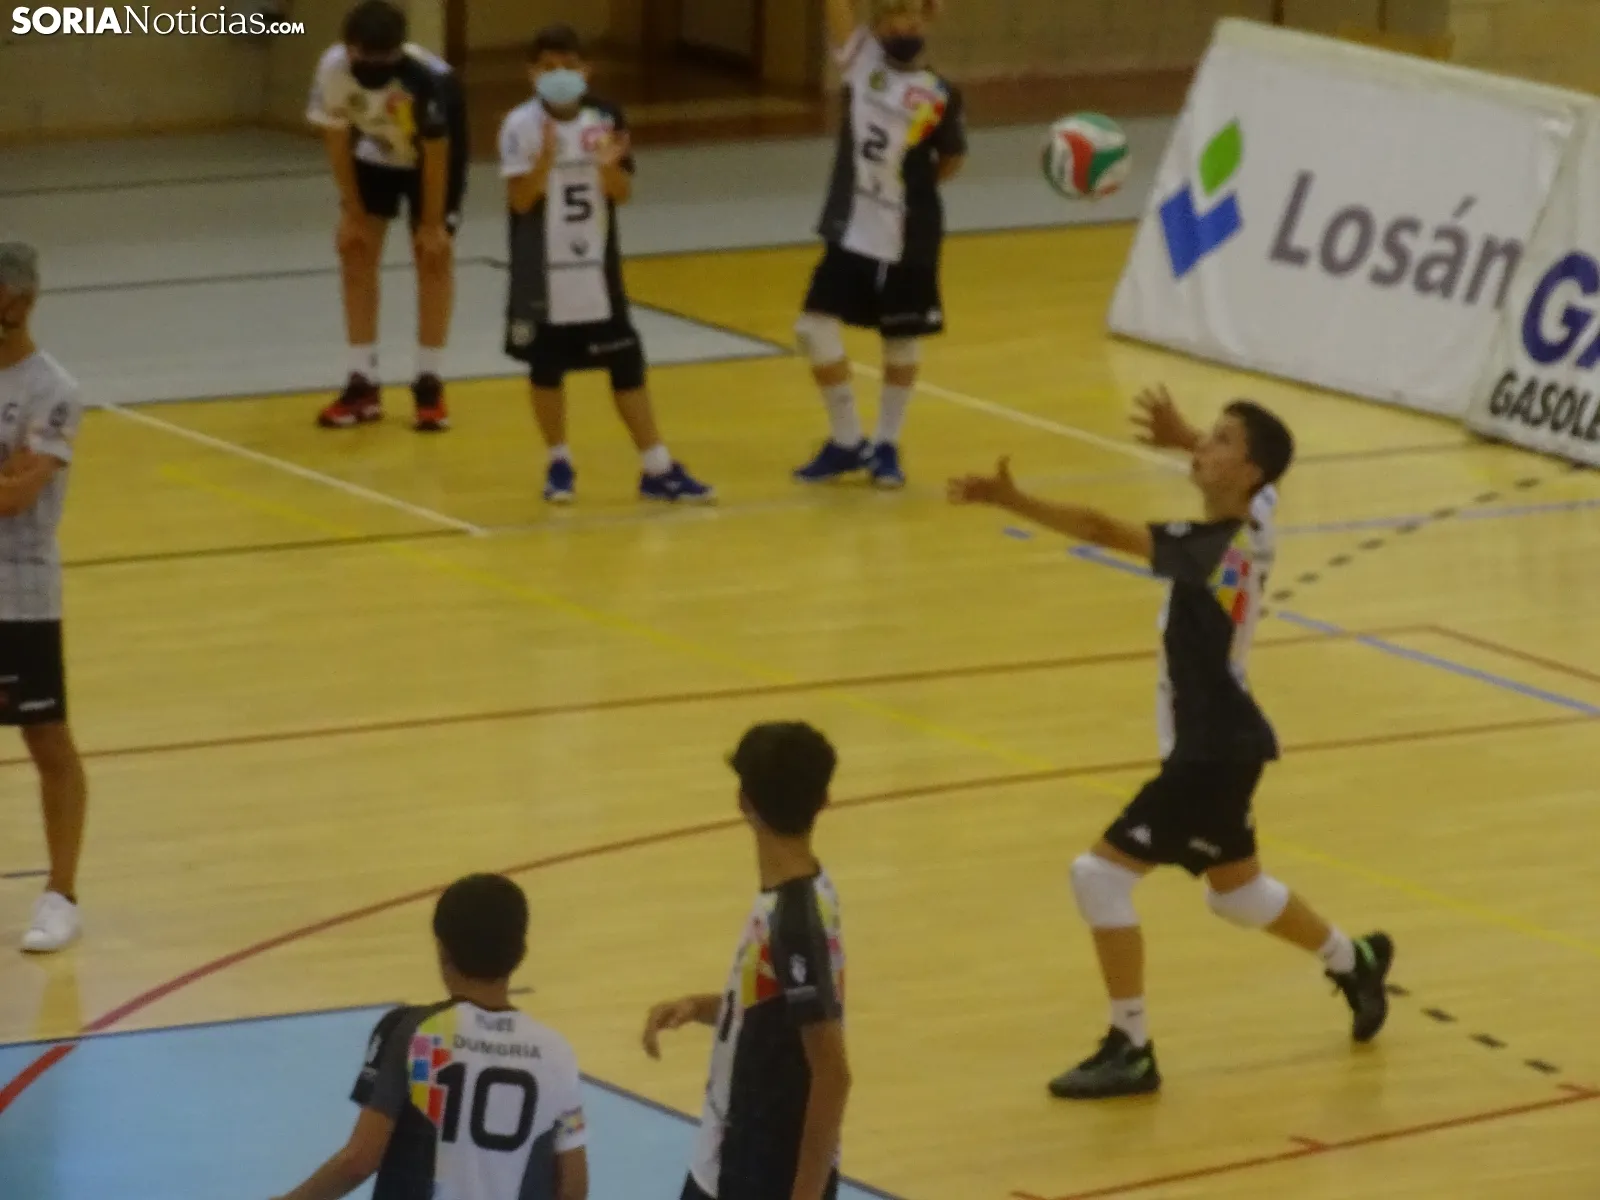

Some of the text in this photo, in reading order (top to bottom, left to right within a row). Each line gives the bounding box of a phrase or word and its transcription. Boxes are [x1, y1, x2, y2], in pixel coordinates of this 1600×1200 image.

[862, 123, 889, 162] 2
[563, 184, 592, 222] 5
[1269, 170, 1523, 310] Losán
[434, 1062, 539, 1152] 10
